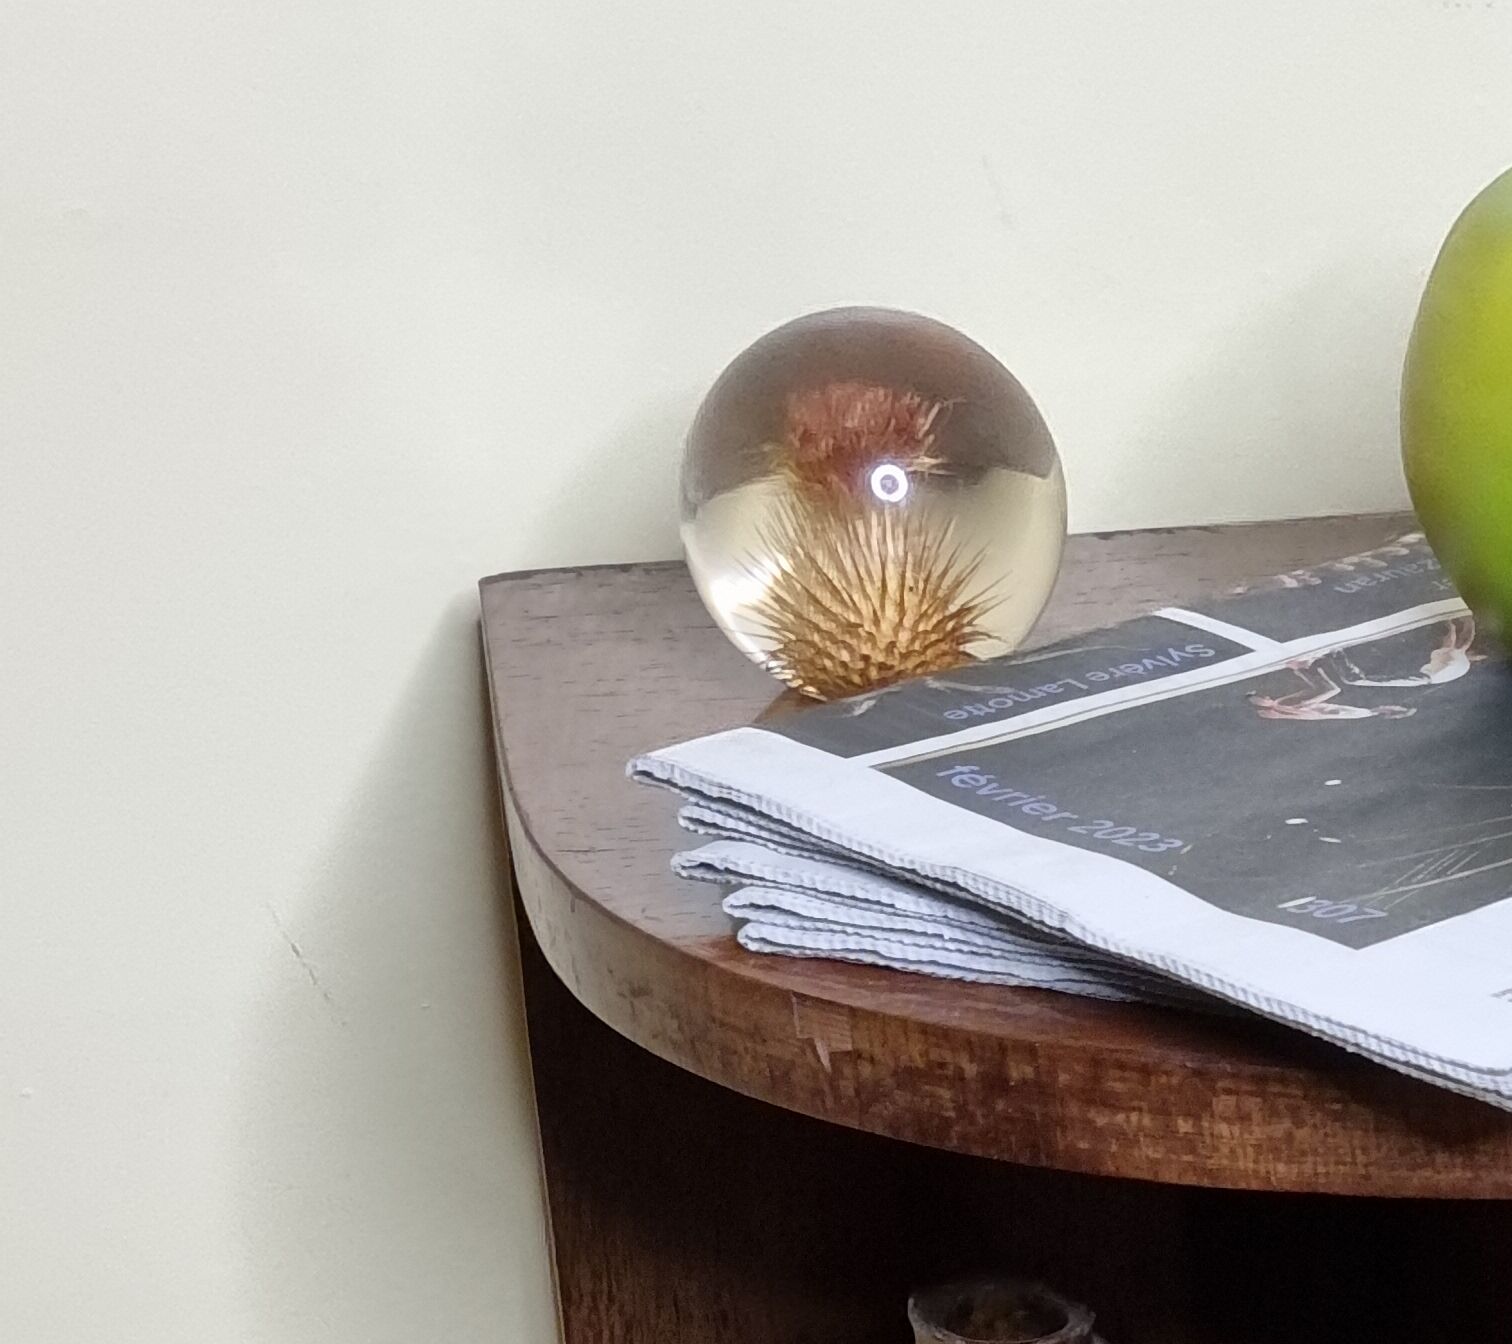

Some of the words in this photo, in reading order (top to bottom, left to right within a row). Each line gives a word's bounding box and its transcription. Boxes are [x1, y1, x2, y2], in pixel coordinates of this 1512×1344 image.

[1085, 643, 1216, 681] Sylvère
[943, 678, 1088, 721] Lamotte
[936, 763, 1078, 822] février
[1067, 819, 1183, 854] 2023
